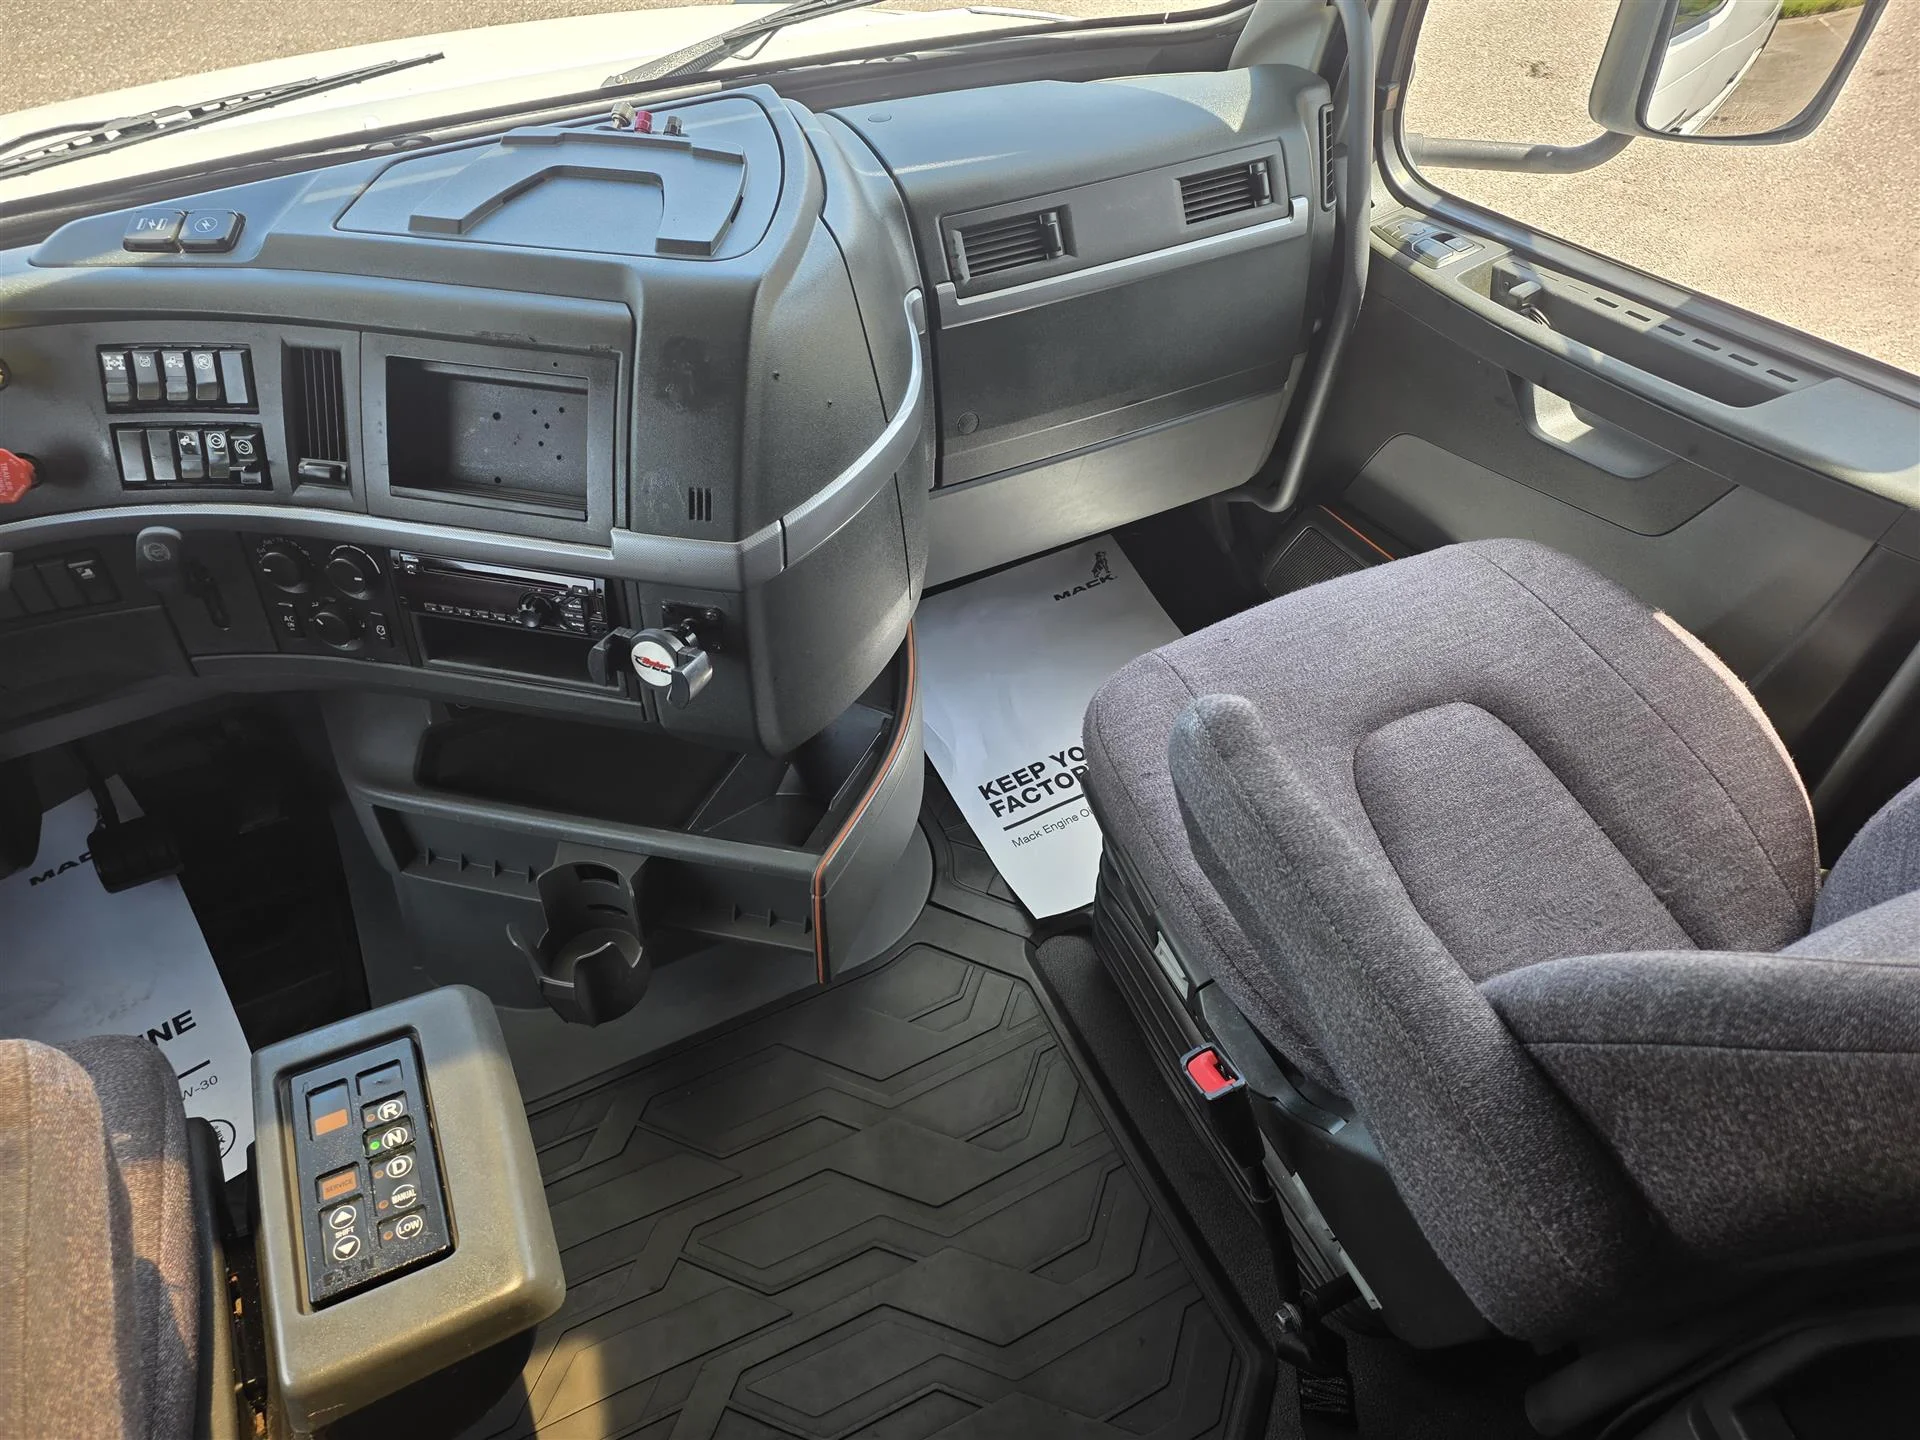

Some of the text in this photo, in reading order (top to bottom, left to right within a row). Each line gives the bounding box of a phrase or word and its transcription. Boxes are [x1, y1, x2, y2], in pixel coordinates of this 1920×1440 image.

[1053, 574, 1114, 601] MACK
[978, 746, 1085, 801] KEEP YO
[989, 764, 1089, 818] FACTOR
[1012, 806, 1094, 847] Mack Engine Oi
[29, 850, 92, 886] MAC
[182, 1075, 218, 1101] W-30
[382, 1102, 398, 1119] R
[386, 1129, 403, 1147] N
[391, 1158, 407, 1175] D
[326, 1178, 354, 1192] SERVICE
[391, 1188, 417, 1204] MANUAL
[335, 1226, 355, 1239] SHIFT
[398, 1219, 420, 1235] LOW
